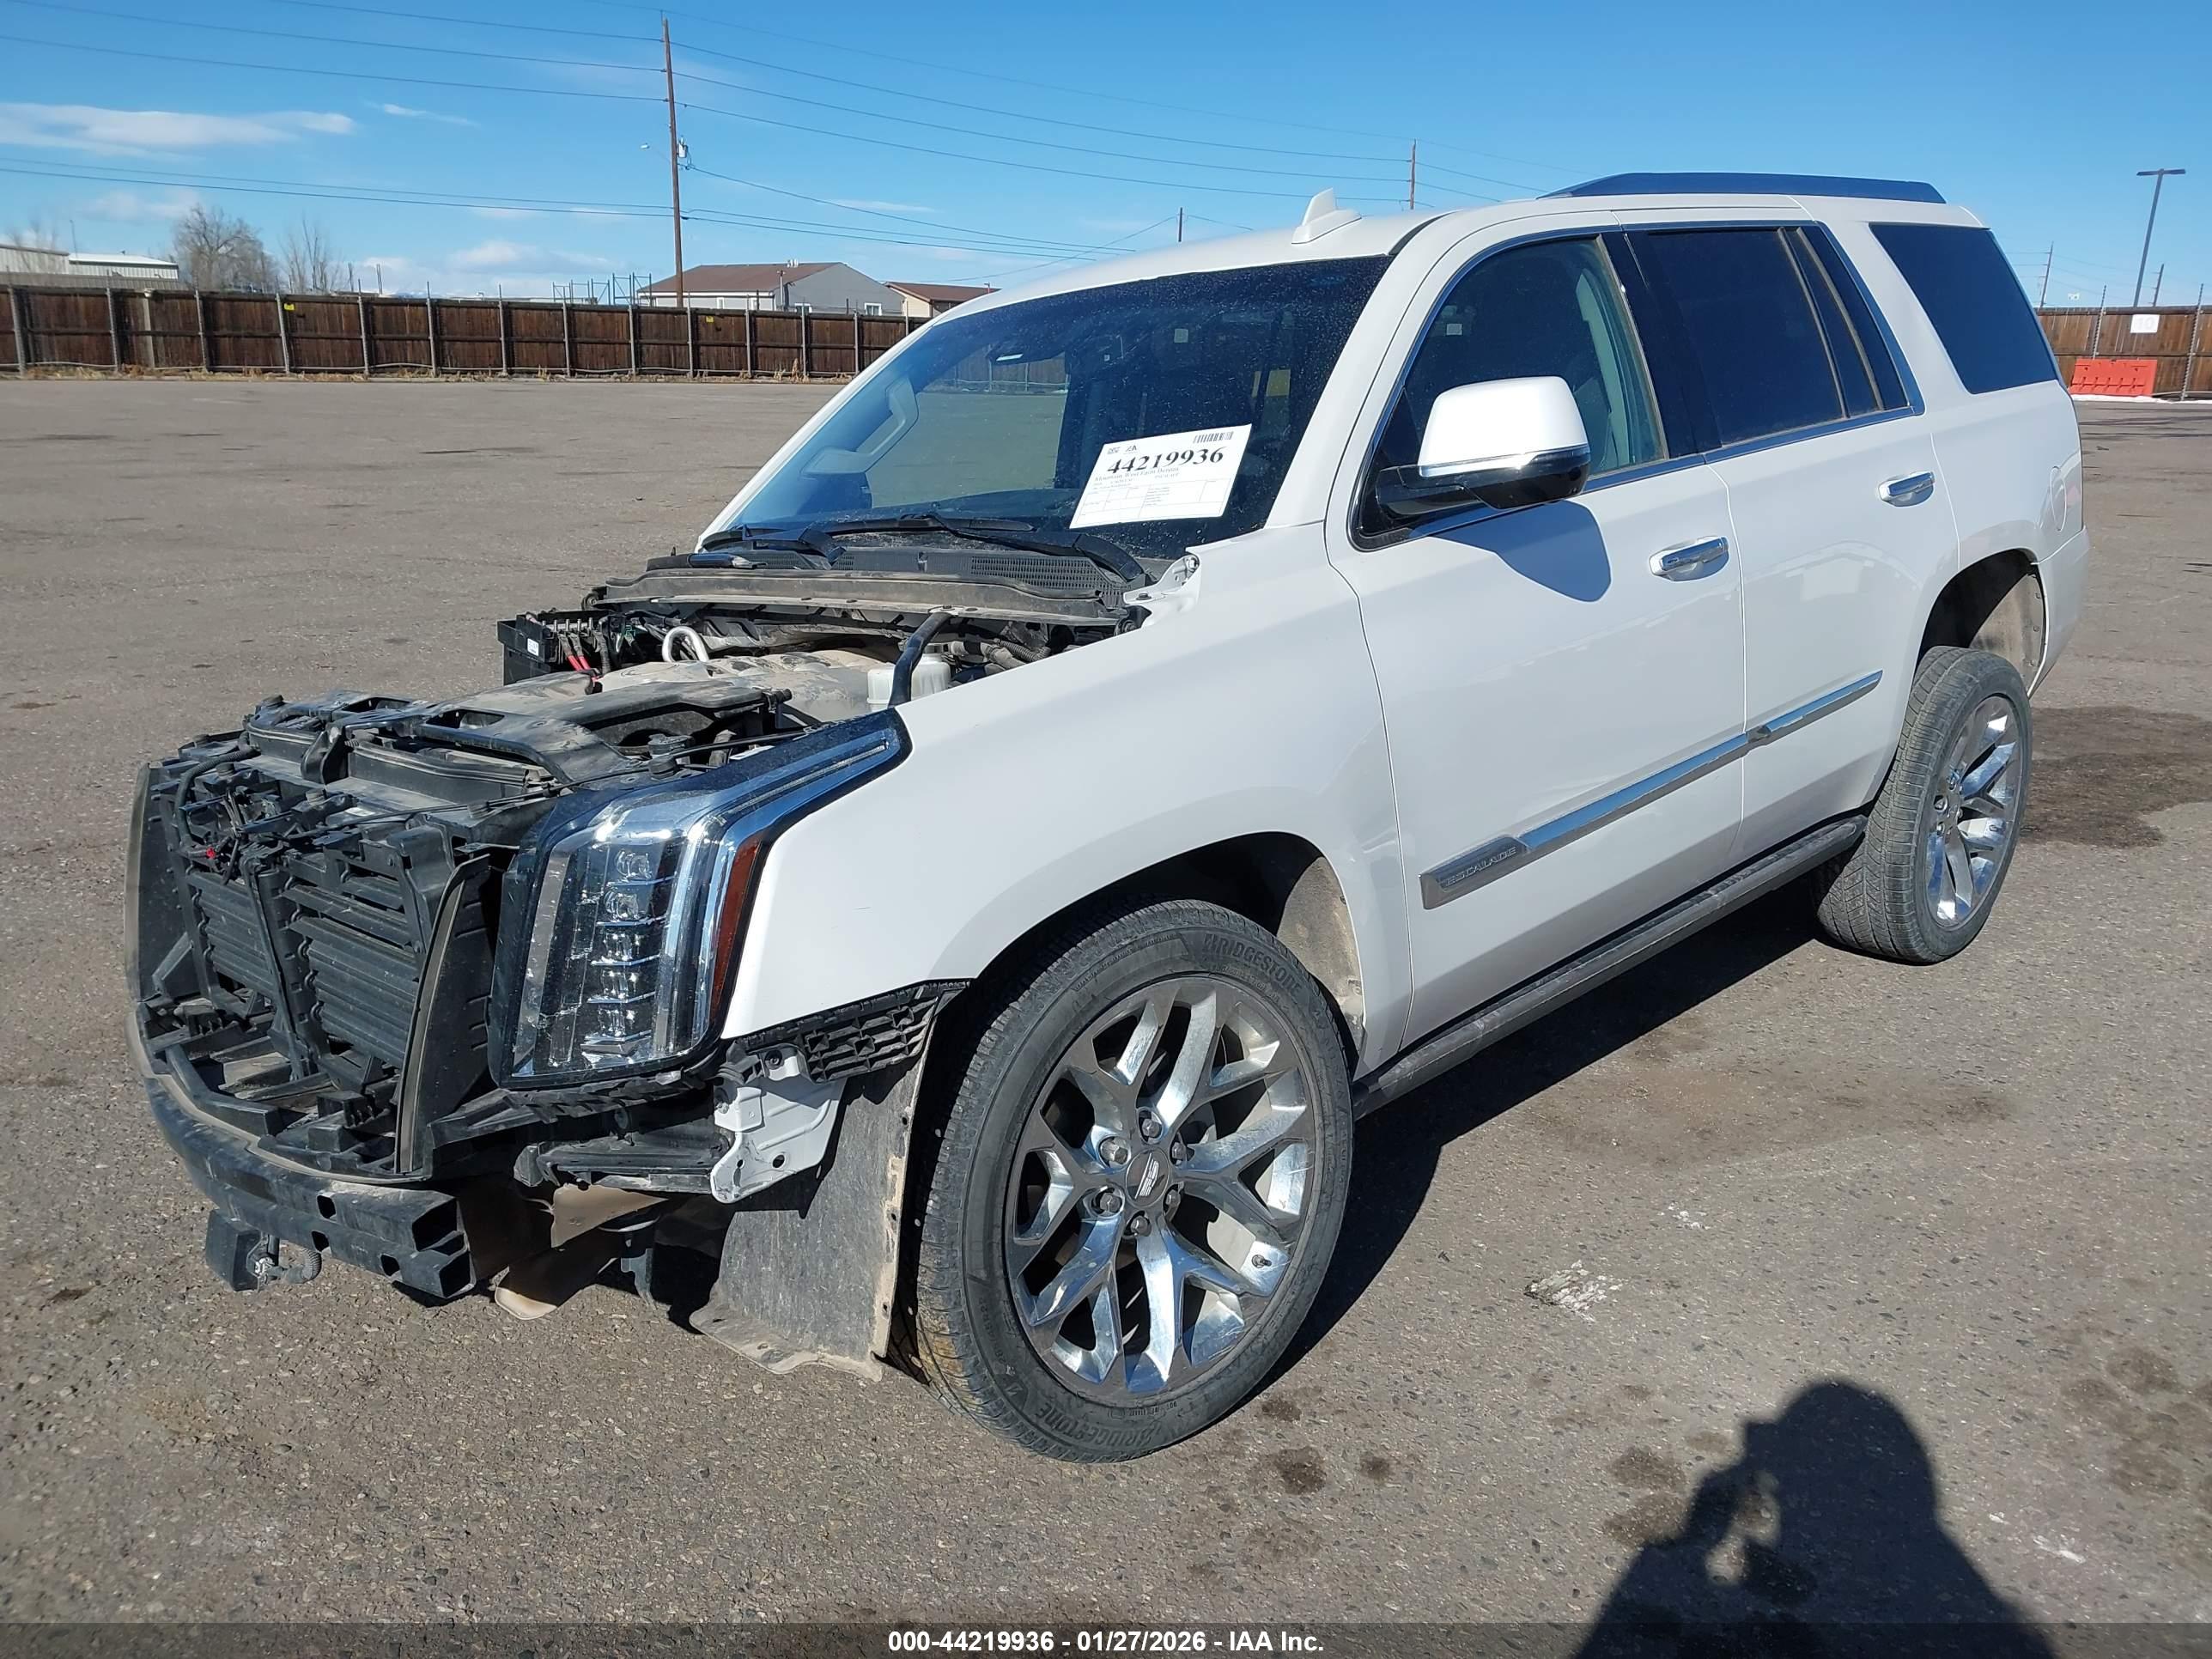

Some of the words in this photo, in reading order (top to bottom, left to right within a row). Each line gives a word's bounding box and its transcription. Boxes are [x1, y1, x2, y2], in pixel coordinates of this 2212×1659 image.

[1107, 446, 1227, 474] 44219936
[1446, 846, 1517, 887] ESCALADE
[1203, 933, 1303, 998] BRIDGESTONE
